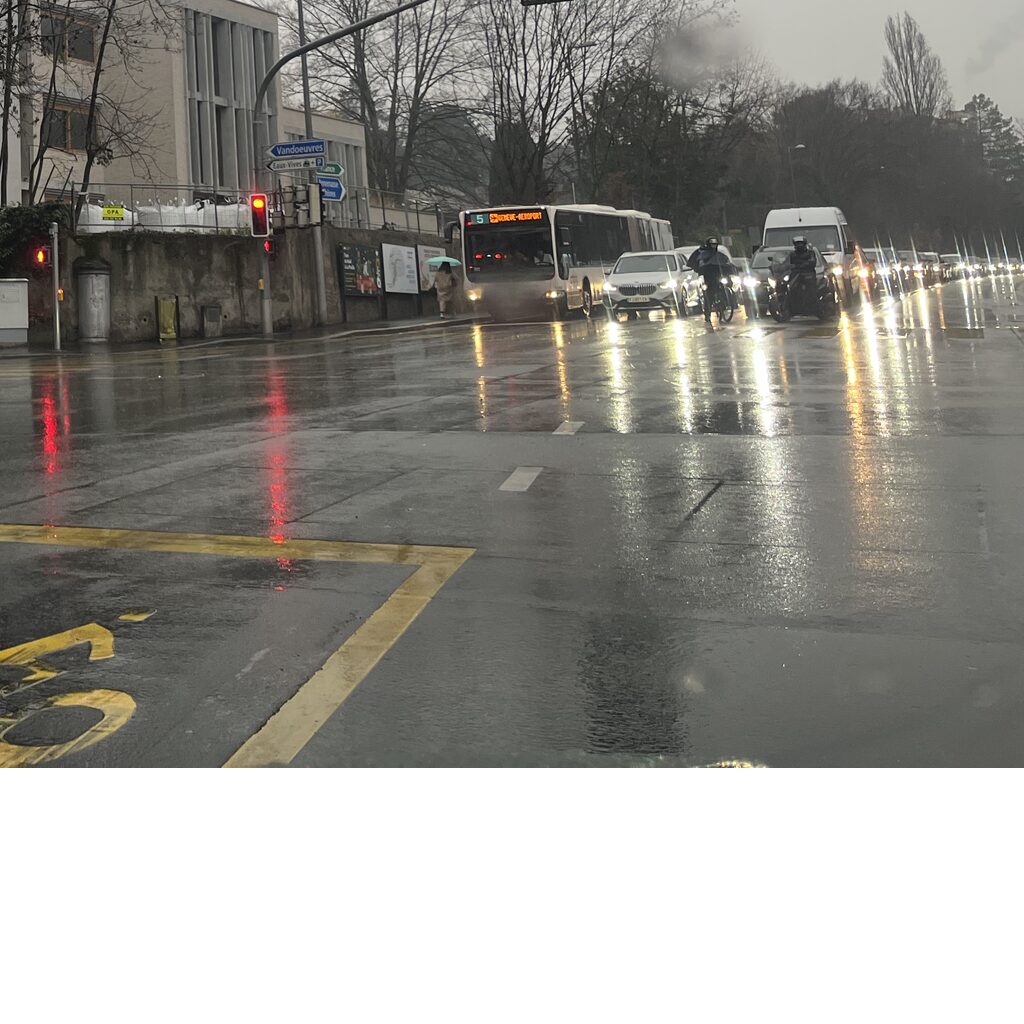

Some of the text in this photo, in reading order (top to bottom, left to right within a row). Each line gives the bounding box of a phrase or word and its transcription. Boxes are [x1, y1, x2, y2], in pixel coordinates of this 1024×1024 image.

[276, 144, 324, 155] Vandoeuvres
[273, 161, 302, 169] Eaux-Vives
[476, 215, 483, 224] 5
